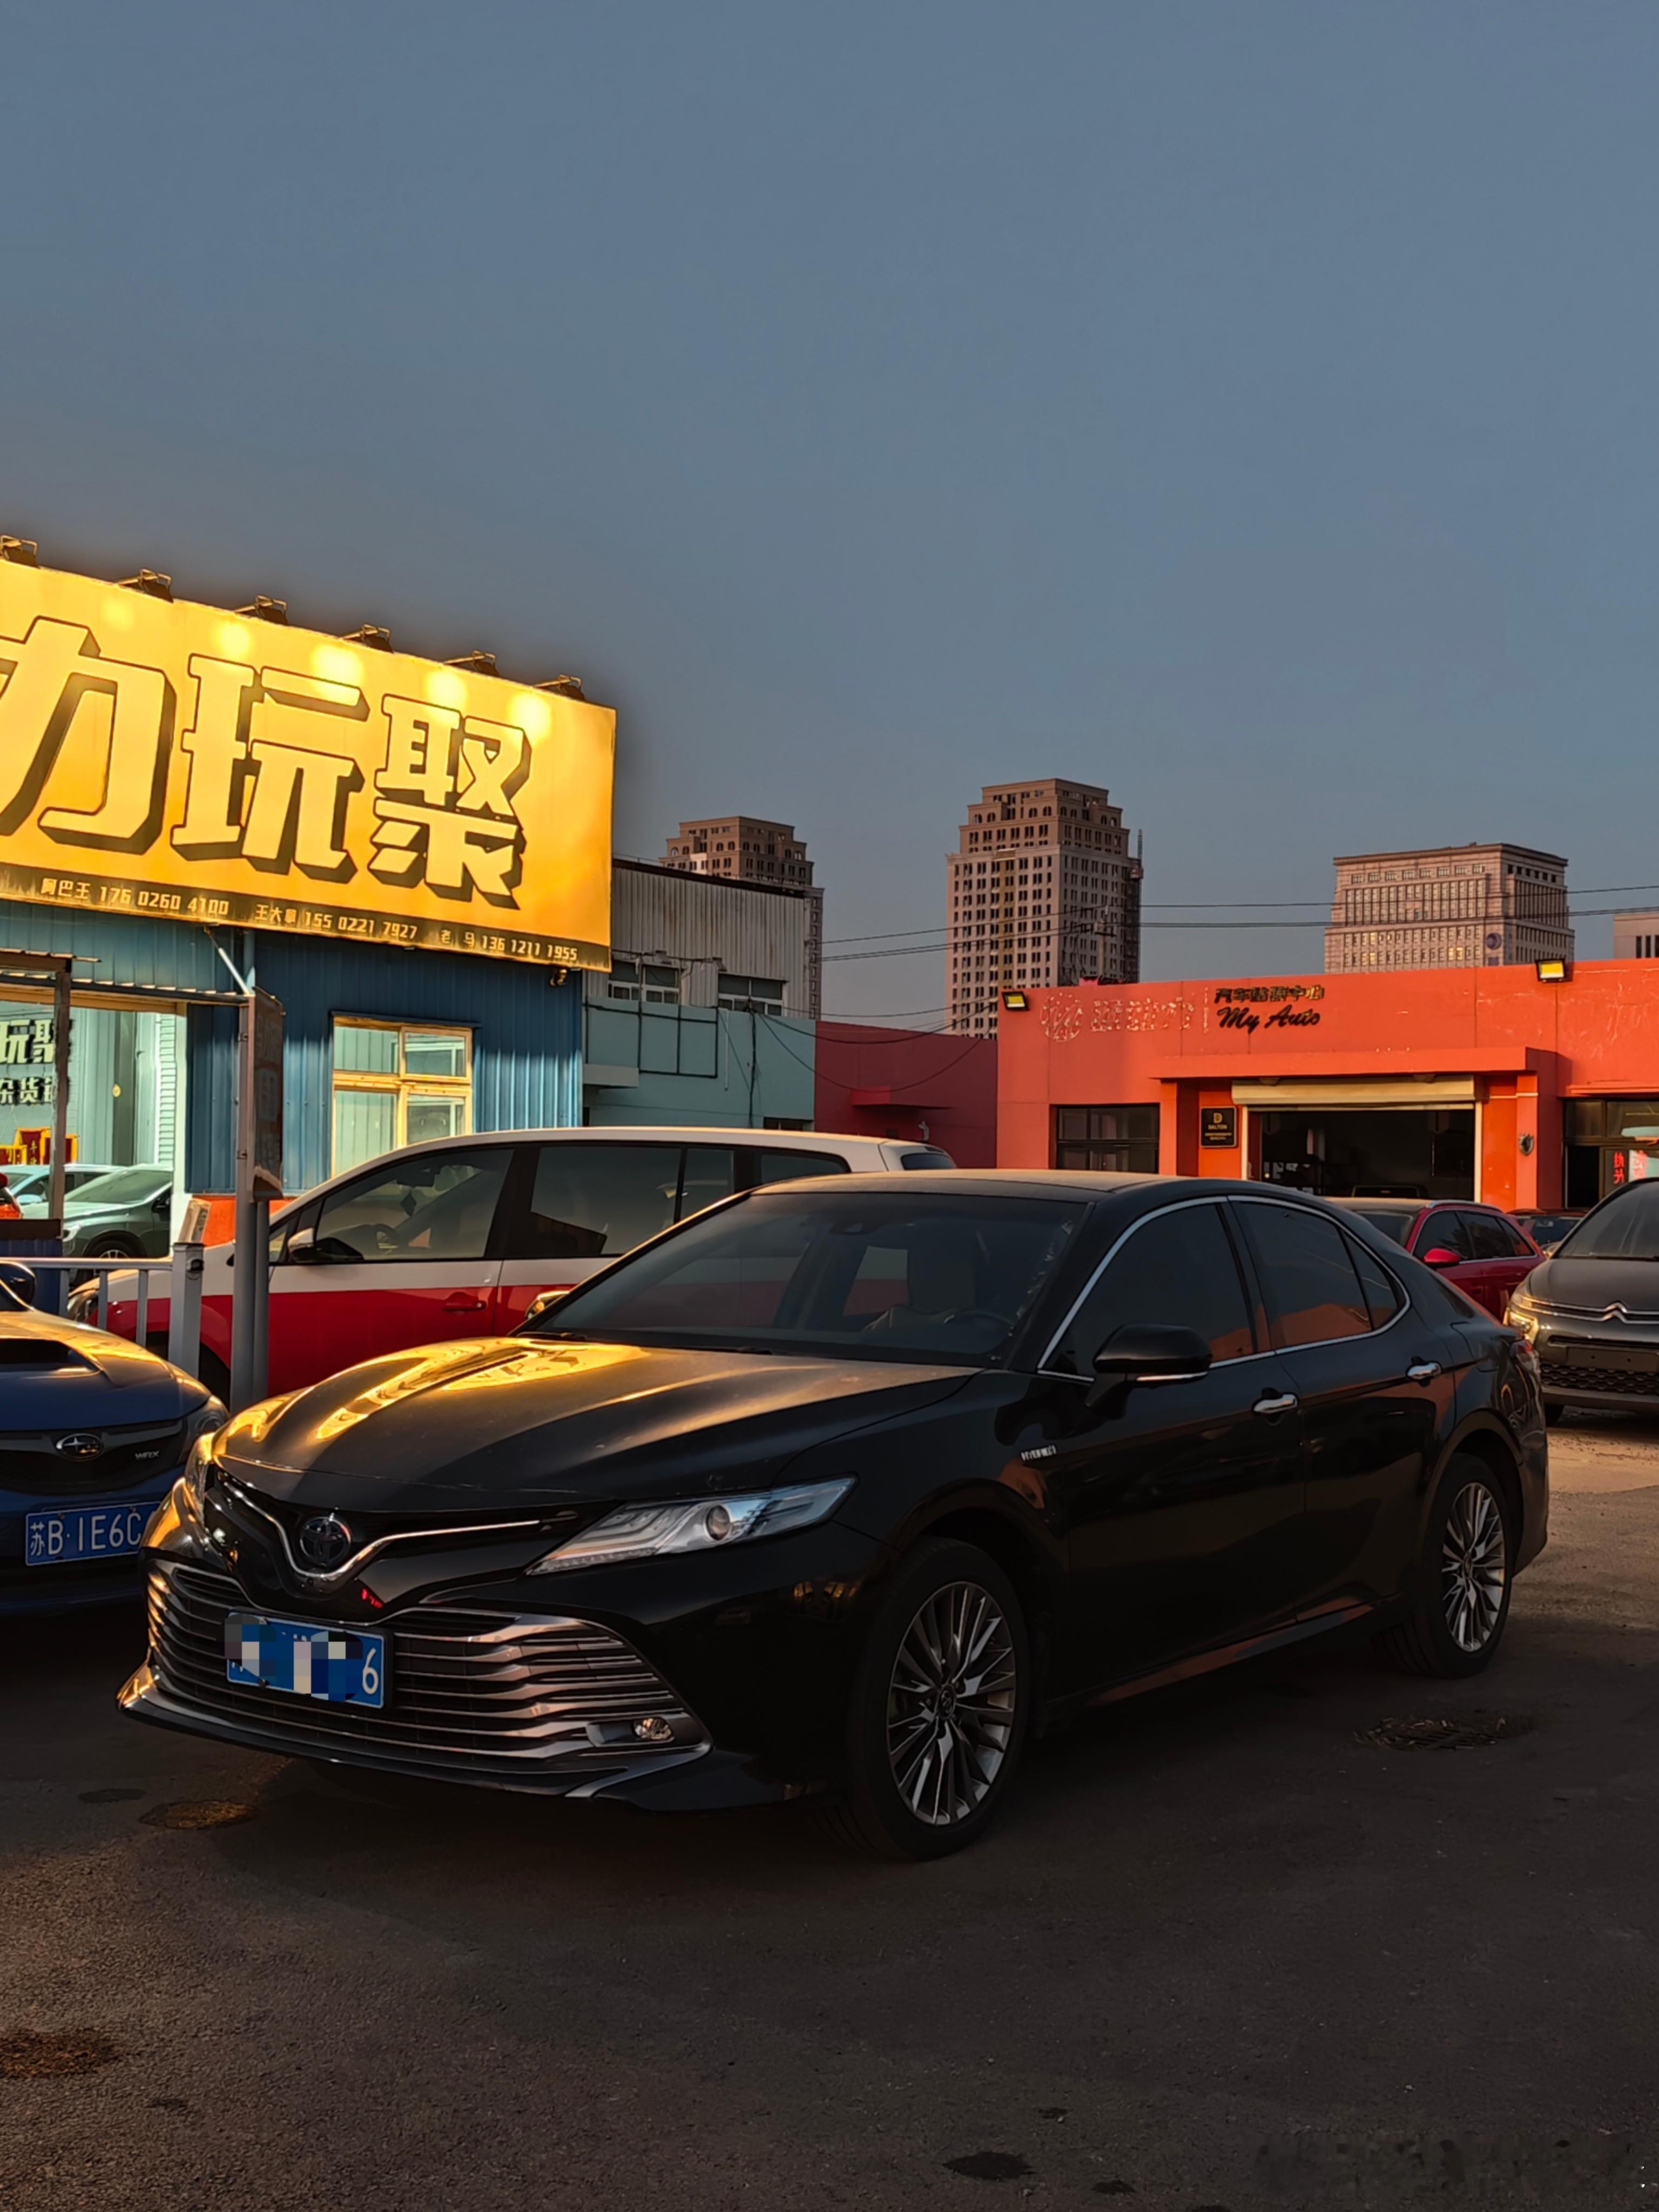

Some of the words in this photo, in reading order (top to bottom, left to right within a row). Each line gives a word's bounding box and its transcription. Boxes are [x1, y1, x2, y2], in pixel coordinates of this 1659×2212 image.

[99, 886, 132, 903] 176
[138, 891, 181, 911] 0260
[187, 896, 230, 915] 4100
[305, 912, 333, 928] 155
[338, 916, 374, 933] 0221
[382, 921, 417, 939] 7927
[482, 935, 505, 951] 136
[511, 940, 540, 956] 1211
[547, 945, 577, 961] 1955
[1217, 1006, 1260, 1034] My
[1264, 1004, 1320, 1029] Auto
[134, 1451, 159, 1459] WRX
[30, 1513, 141, 1556] 苏B·1E6C
